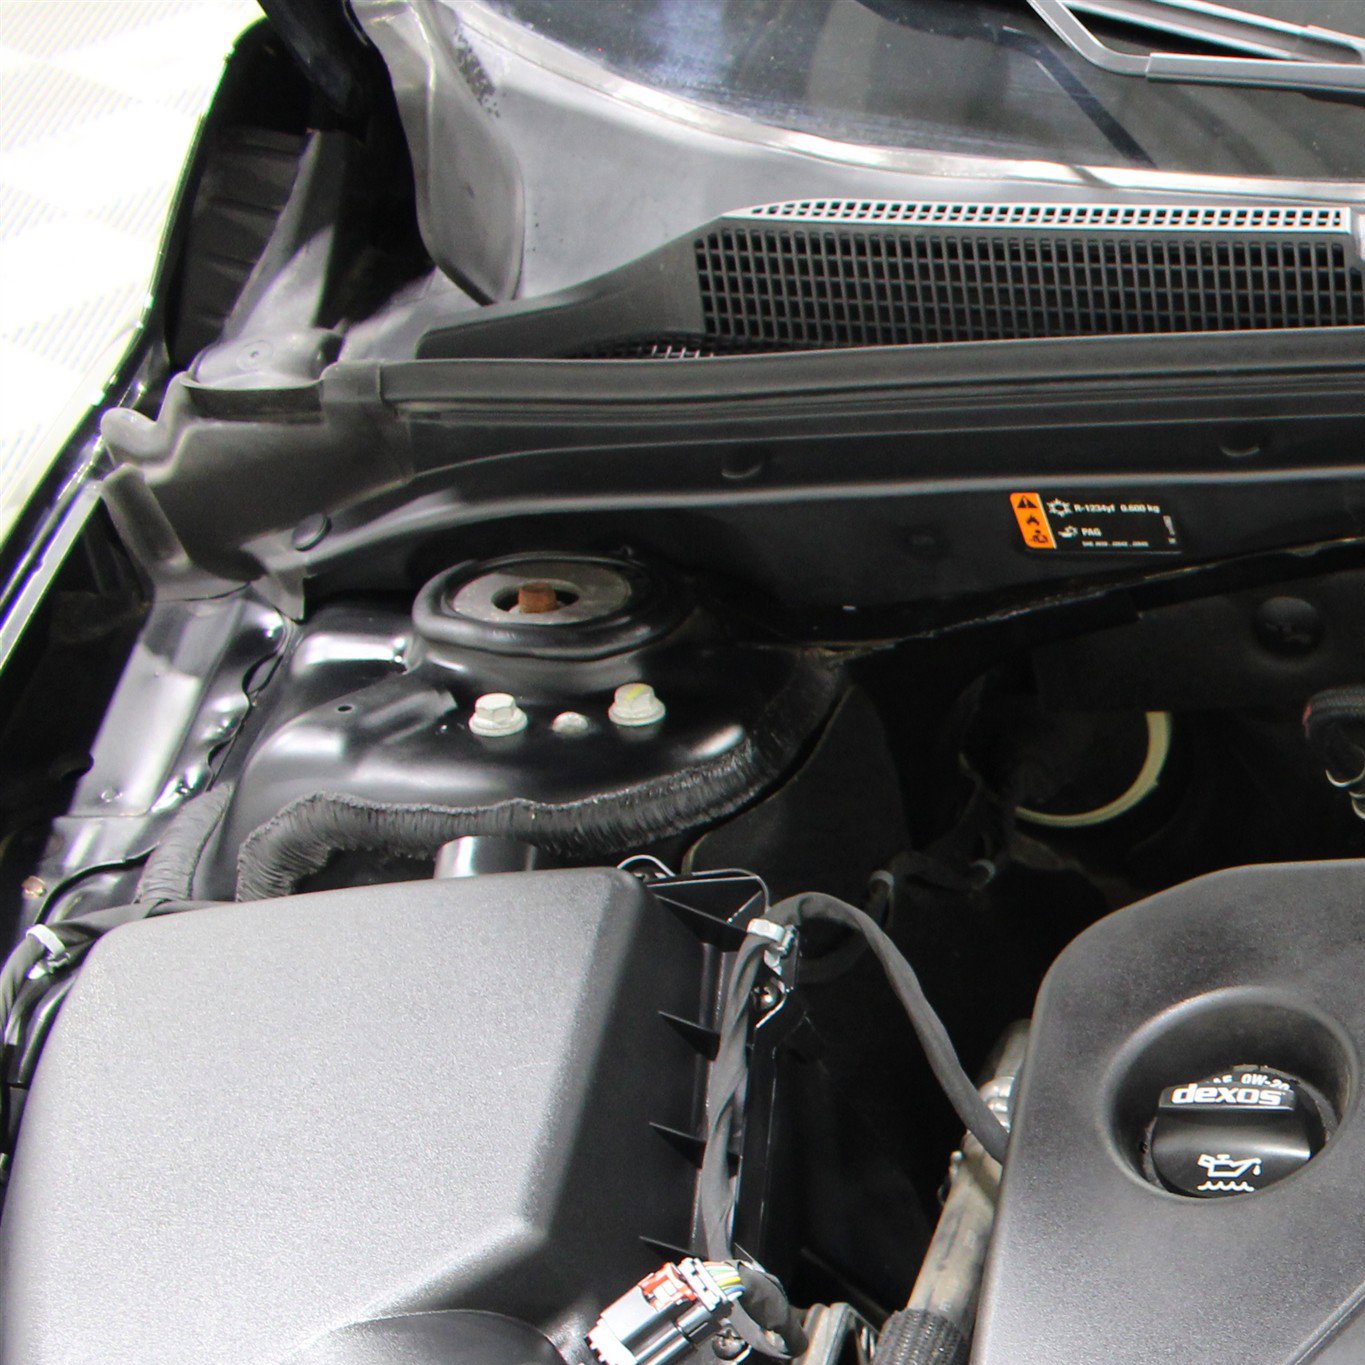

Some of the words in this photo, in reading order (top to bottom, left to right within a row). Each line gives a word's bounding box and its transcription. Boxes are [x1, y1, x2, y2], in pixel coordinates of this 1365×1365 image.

[1074, 504, 1115, 514] R-1234yf
[1147, 504, 1160, 514] kg
[1081, 527, 1102, 537] PAG
[1171, 1083, 1282, 1106] dexos
